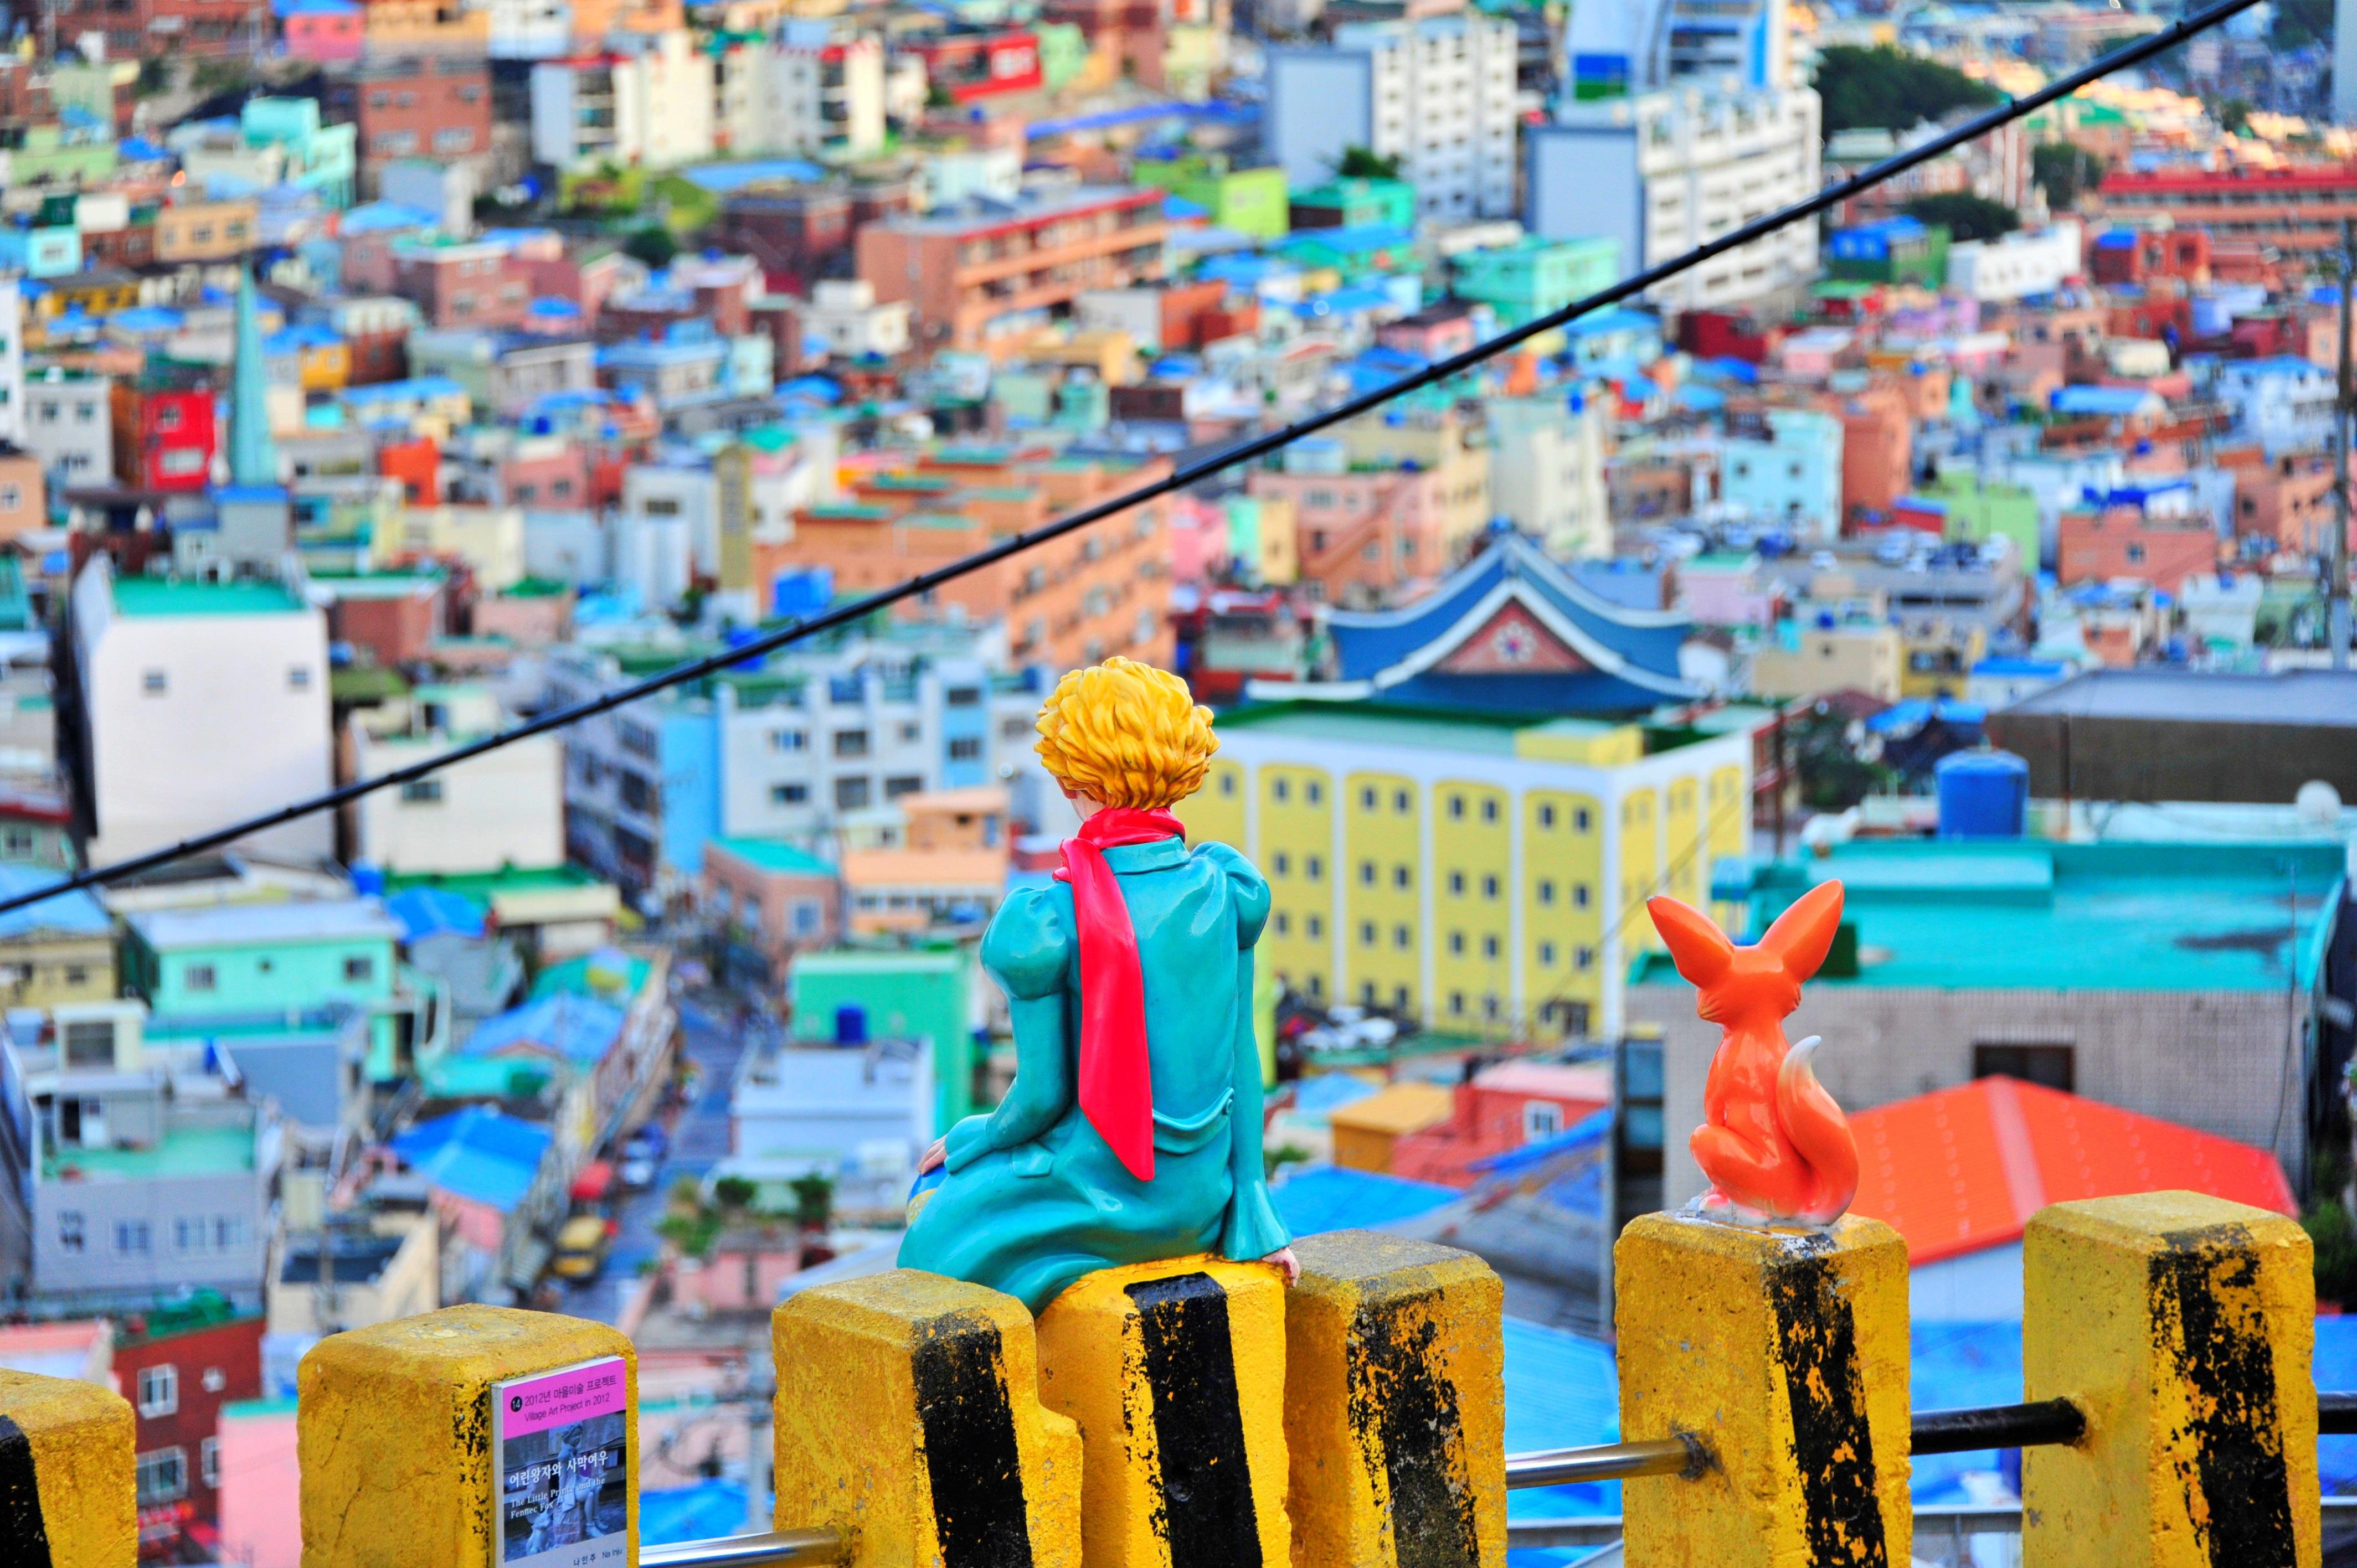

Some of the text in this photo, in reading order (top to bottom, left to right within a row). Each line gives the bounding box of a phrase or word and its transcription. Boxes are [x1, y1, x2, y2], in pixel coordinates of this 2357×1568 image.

[524, 1391, 550, 1407] 2012년
[554, 1383, 584, 1400] 마을미술
[586, 1375, 616, 1391] 프로젝트
[524, 1393, 610, 1422] Village Art Project in 2012
[510, 1451, 608, 1488] 어린왕자와 사막여우
[511, 1477, 605, 1508] The Little Prince and the
[511, 1502, 554, 1519] Fennec Fox
